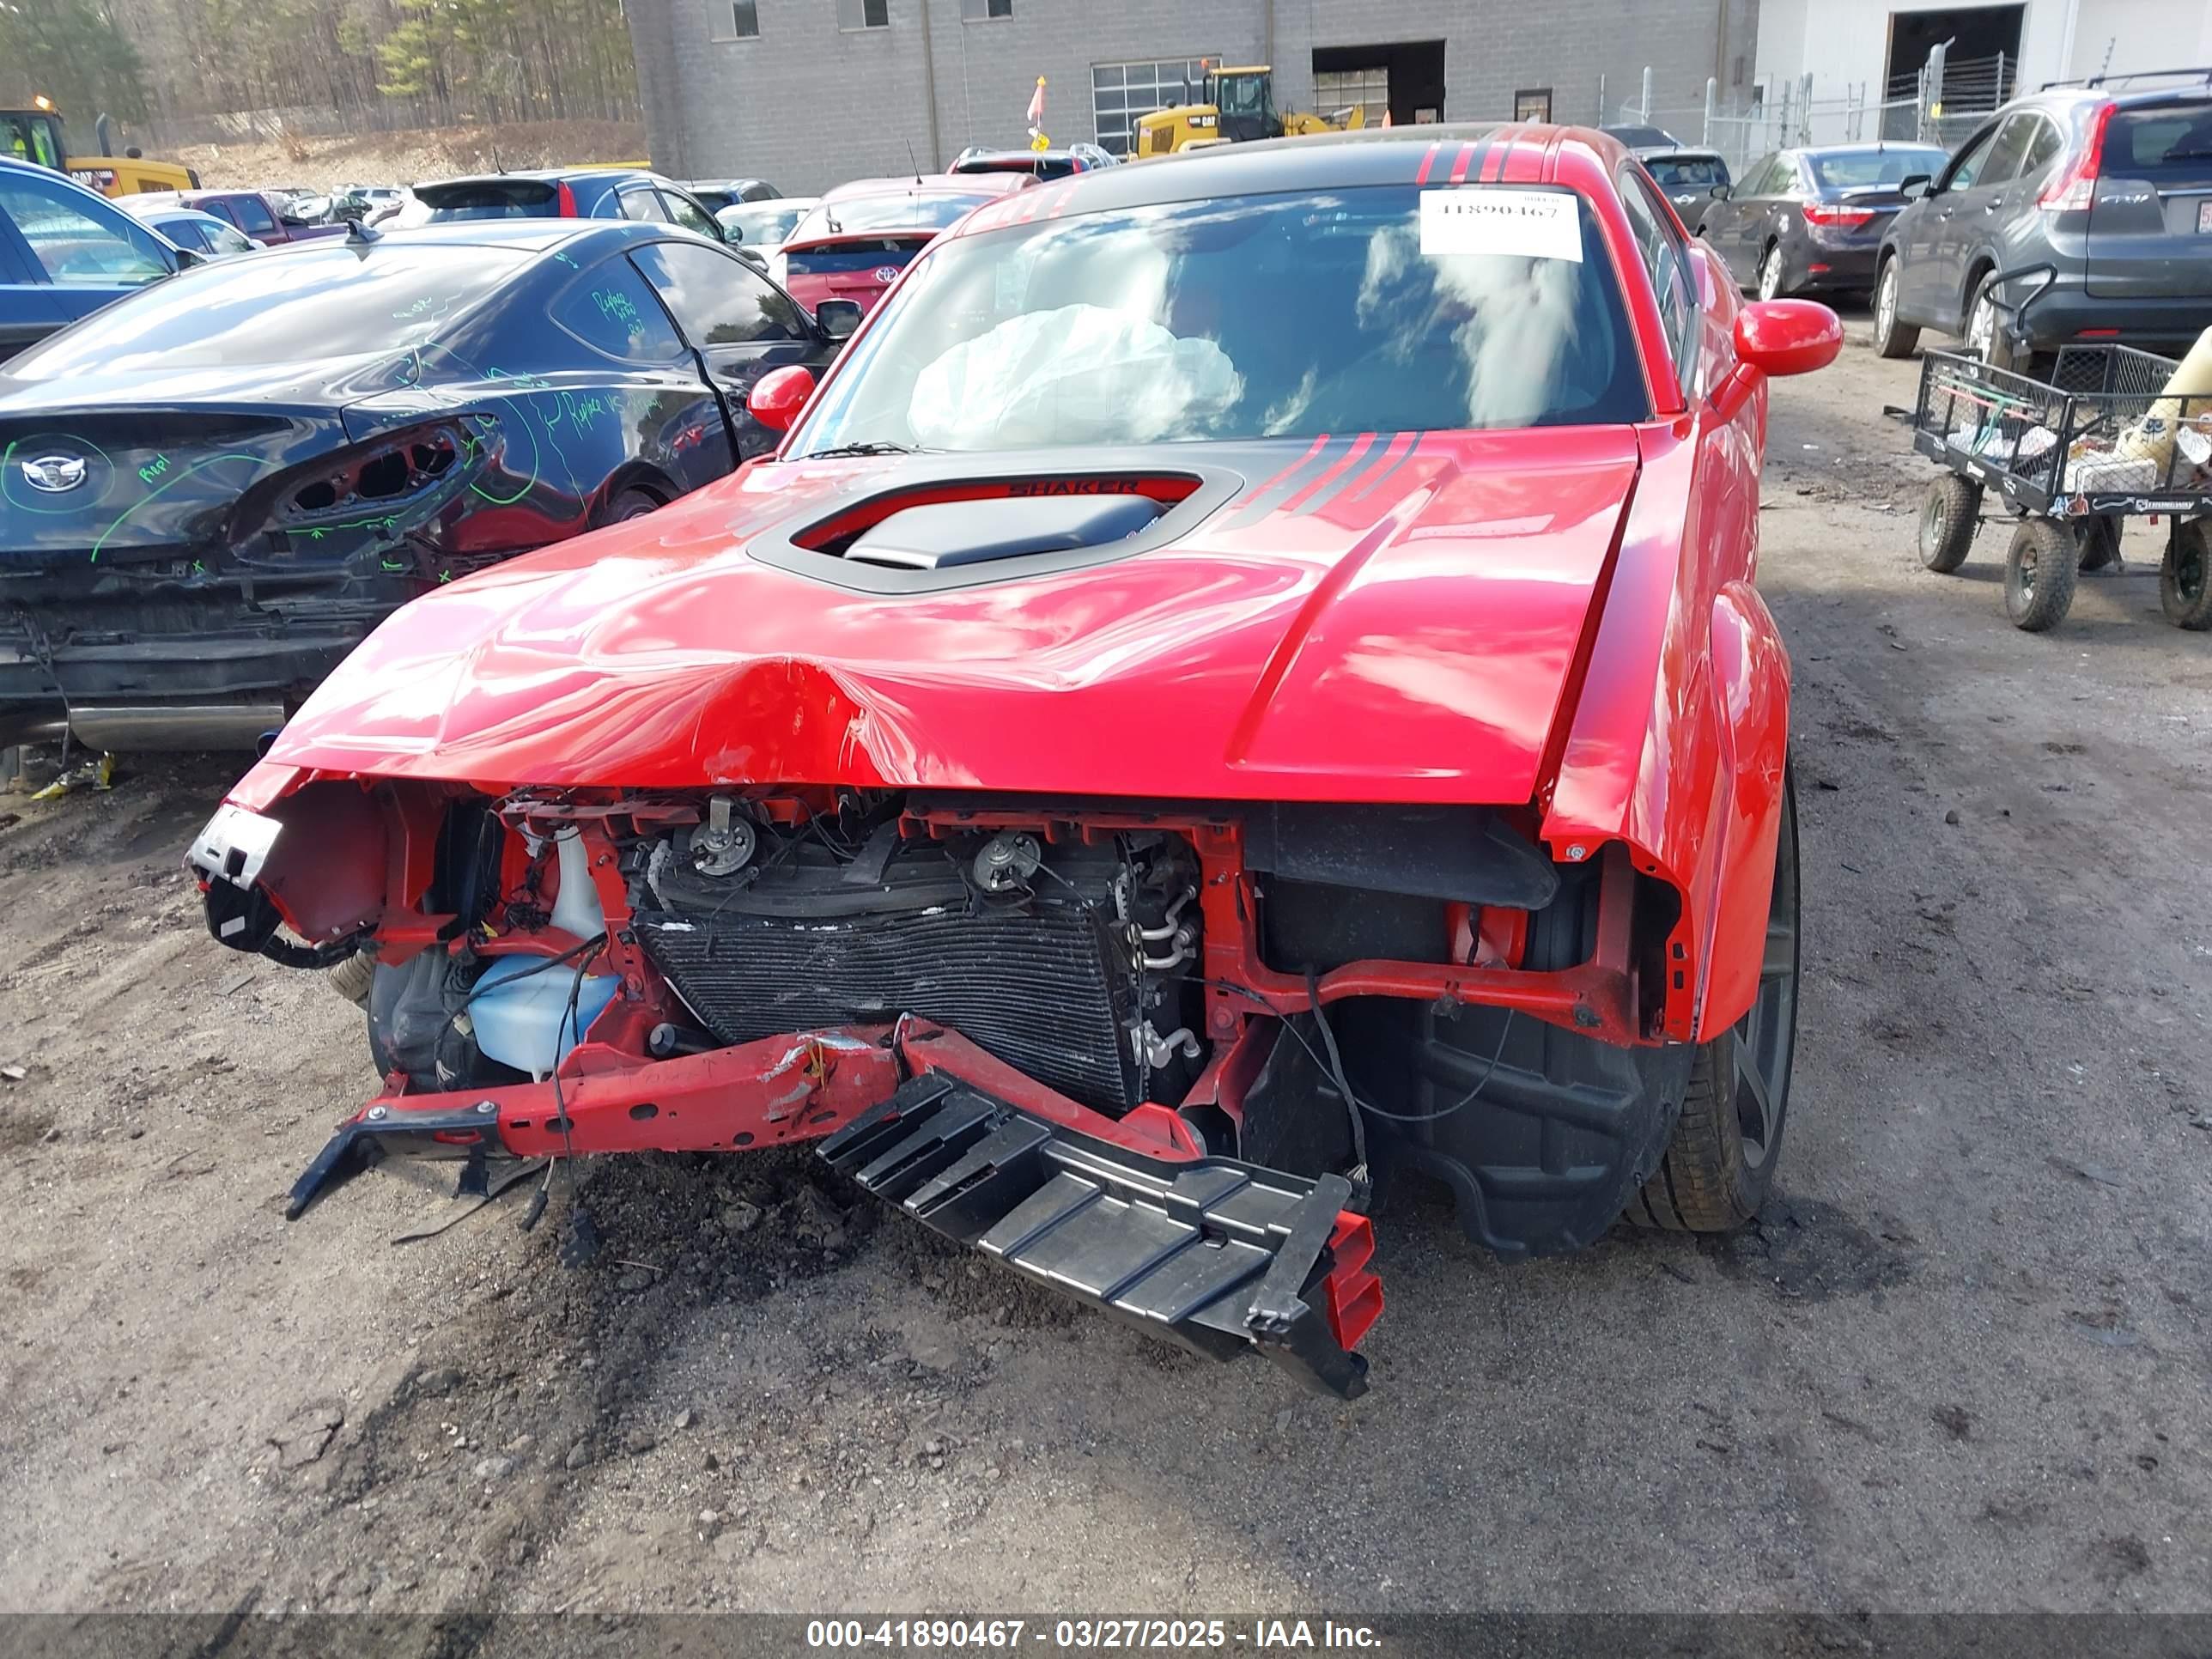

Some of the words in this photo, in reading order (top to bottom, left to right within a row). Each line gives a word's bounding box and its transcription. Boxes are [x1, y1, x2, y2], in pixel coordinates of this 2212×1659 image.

[1202, 116, 1215, 127] CAT
[71, 171, 93, 185] CAT
[1009, 480, 1139, 496] SHAKER
